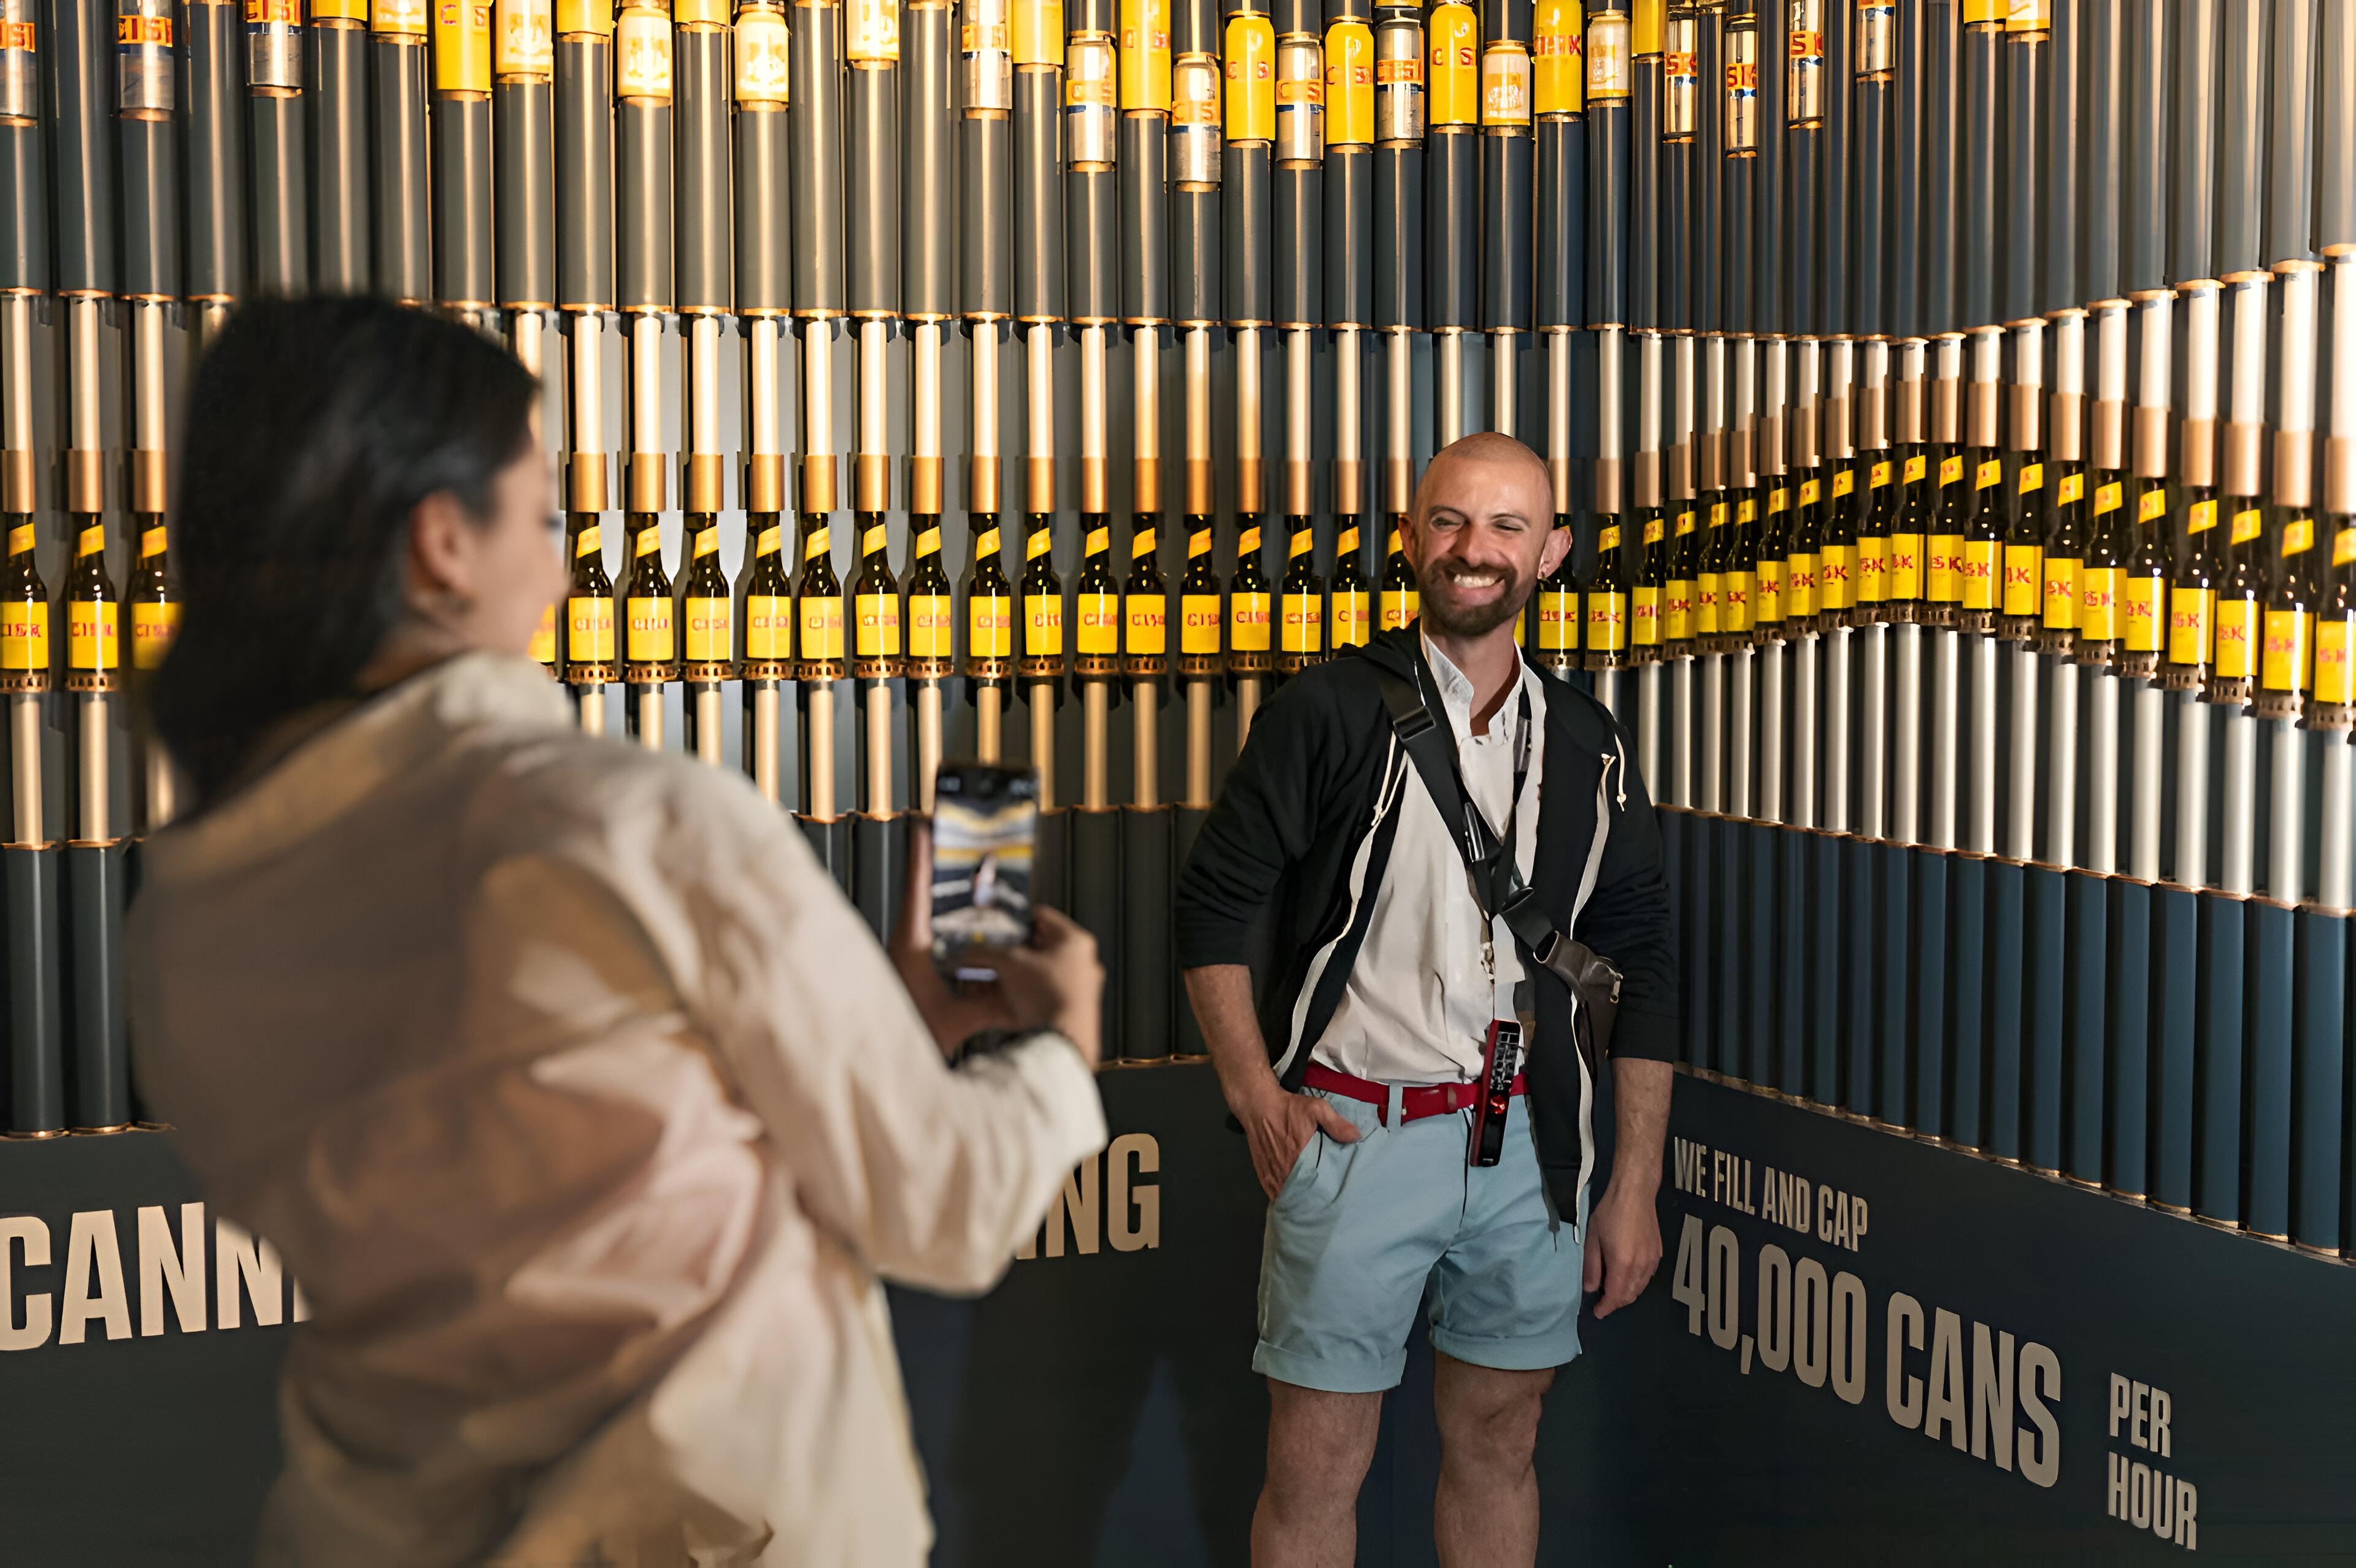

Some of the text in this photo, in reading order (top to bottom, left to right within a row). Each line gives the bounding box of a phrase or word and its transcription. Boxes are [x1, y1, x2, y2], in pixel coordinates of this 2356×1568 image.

[1016, 1133, 1160, 1259] NG
[1674, 1137, 1868, 1252] WE FILL AND CAP
[1672, 1213, 2062, 1488] 40,000 CANS
[2109, 1372, 2171, 1458] PER
[2108, 1451, 2197, 1550] HOUR
